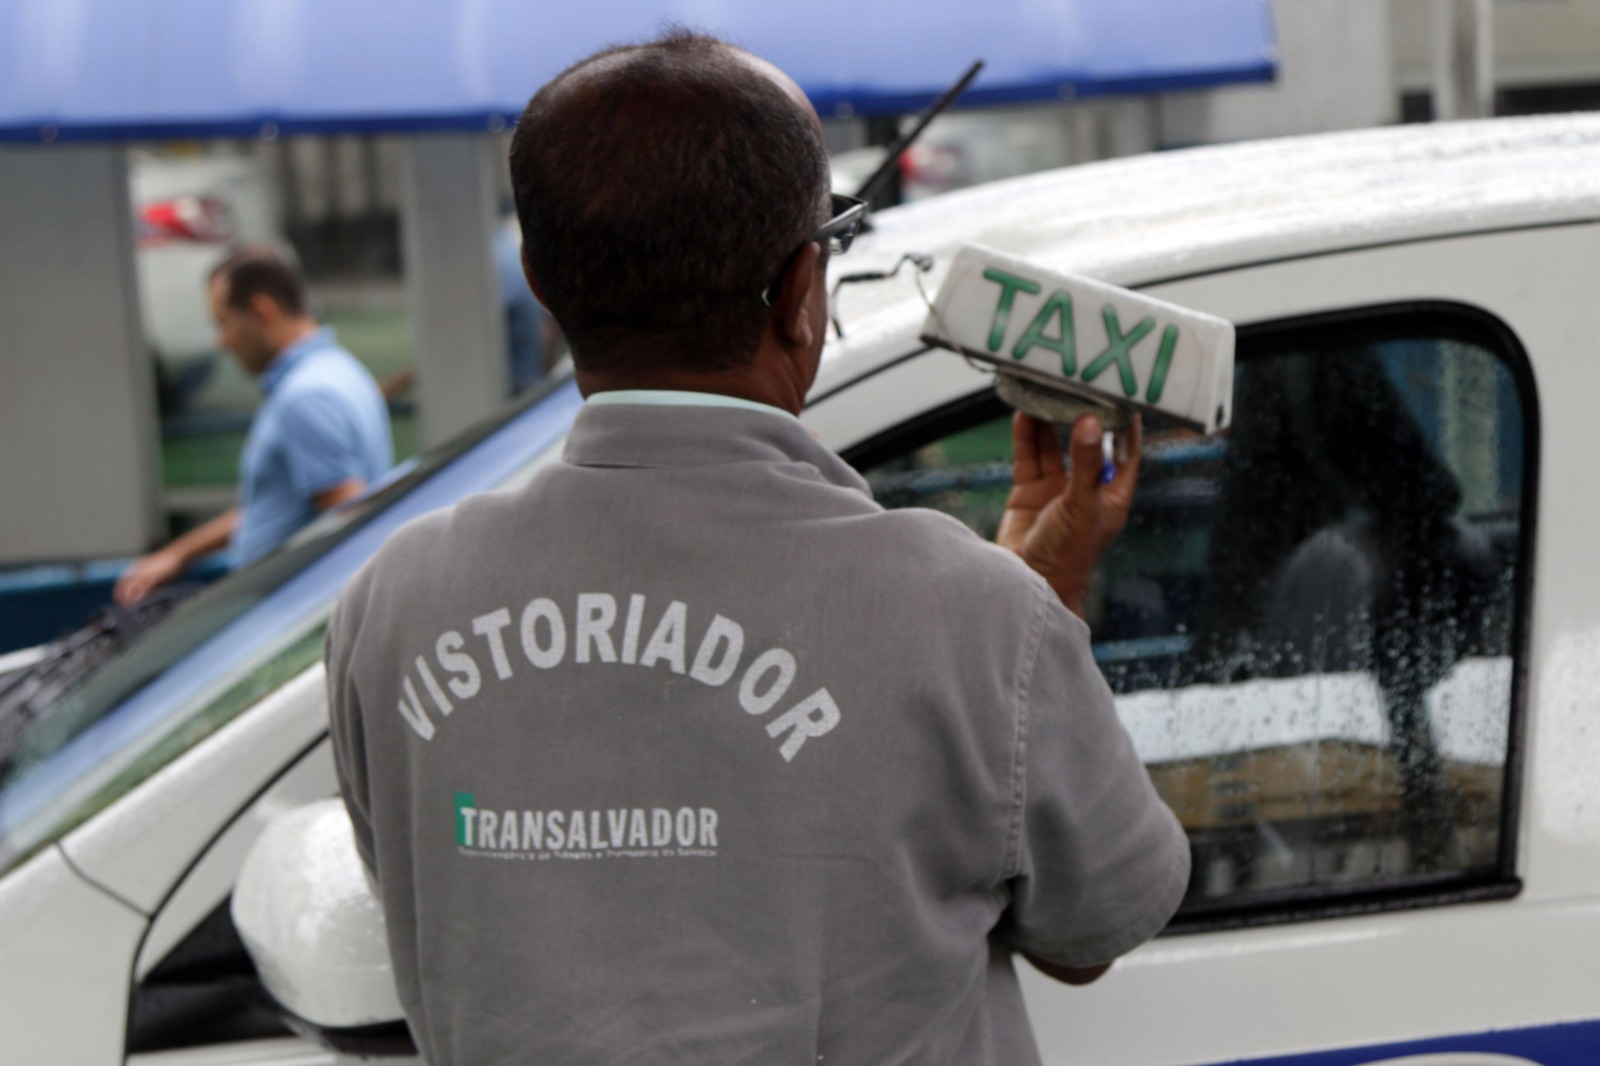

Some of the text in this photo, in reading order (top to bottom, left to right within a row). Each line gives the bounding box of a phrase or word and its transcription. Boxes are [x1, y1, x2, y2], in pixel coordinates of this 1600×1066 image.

[983, 267, 1179, 403] TAXI
[398, 592, 841, 763] VISTORIADOR
[459, 807, 719, 850] TRANSALVADOR
